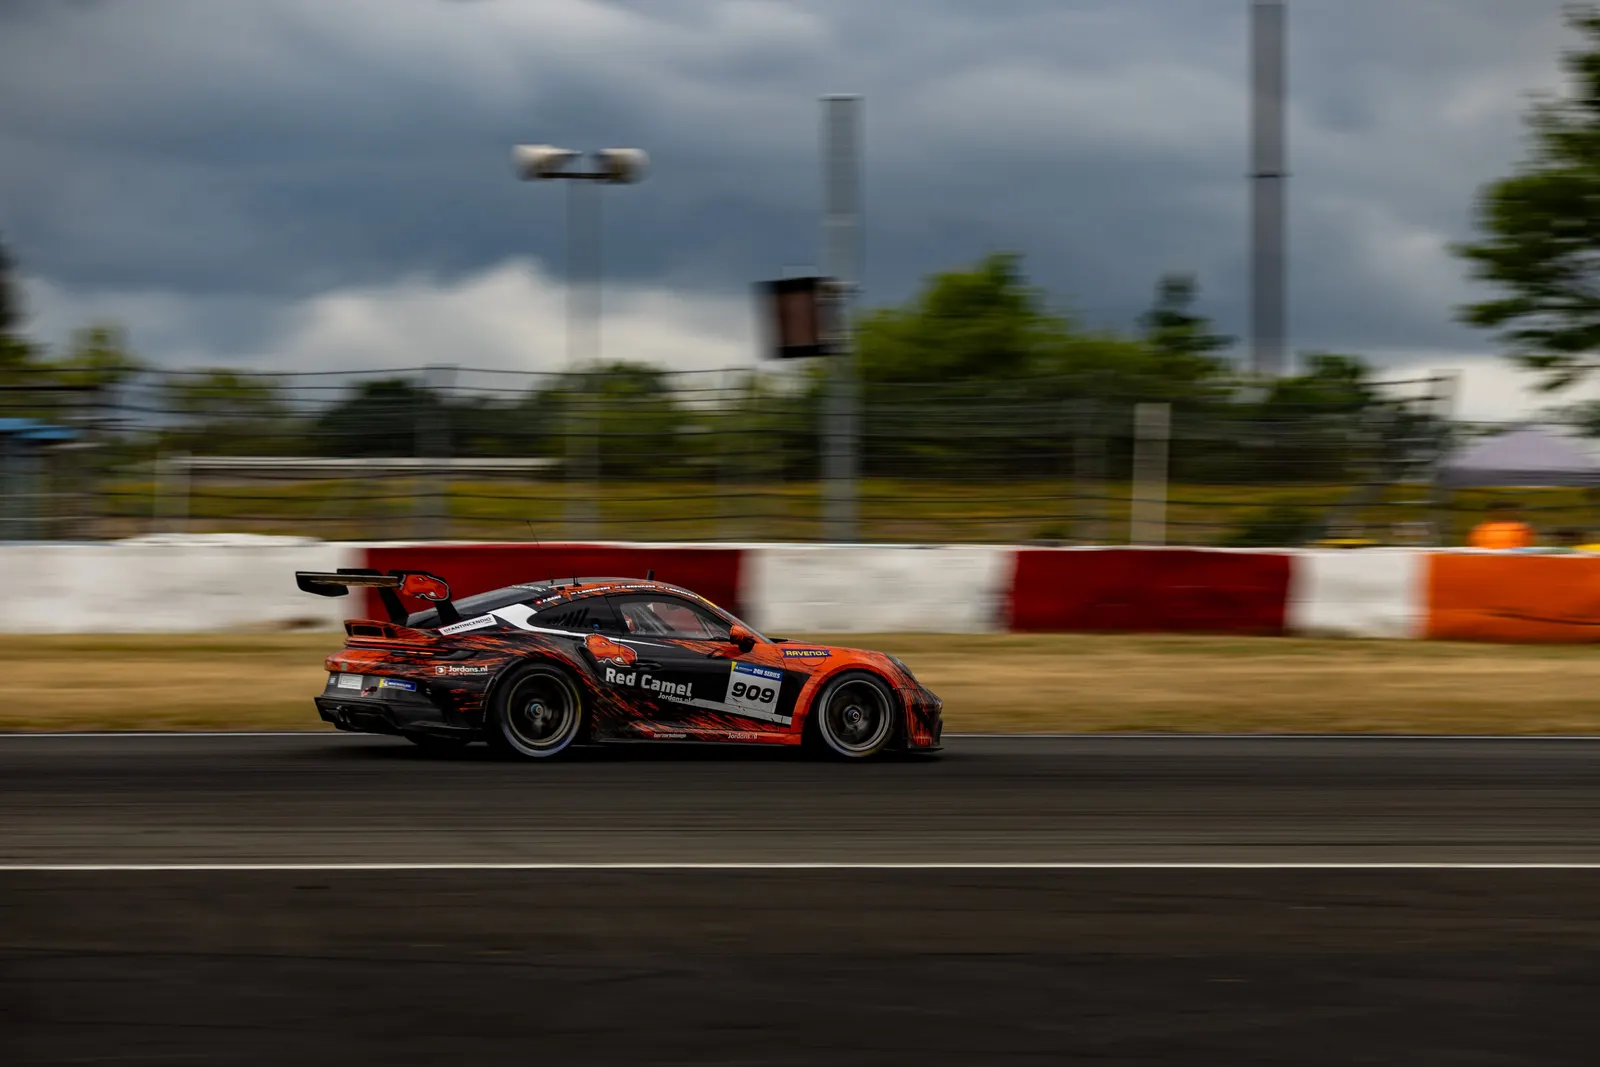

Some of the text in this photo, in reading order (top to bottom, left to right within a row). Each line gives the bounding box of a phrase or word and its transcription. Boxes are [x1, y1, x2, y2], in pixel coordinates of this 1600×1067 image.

[448, 665, 488, 673] Jordans.nl
[763, 670, 781, 679] SERIES
[605, 667, 692, 697] Red Camel
[658, 692, 691, 703] Jordans.nl
[731, 682, 775, 703] 909
[727, 732, 758, 740] Jordans.nl
